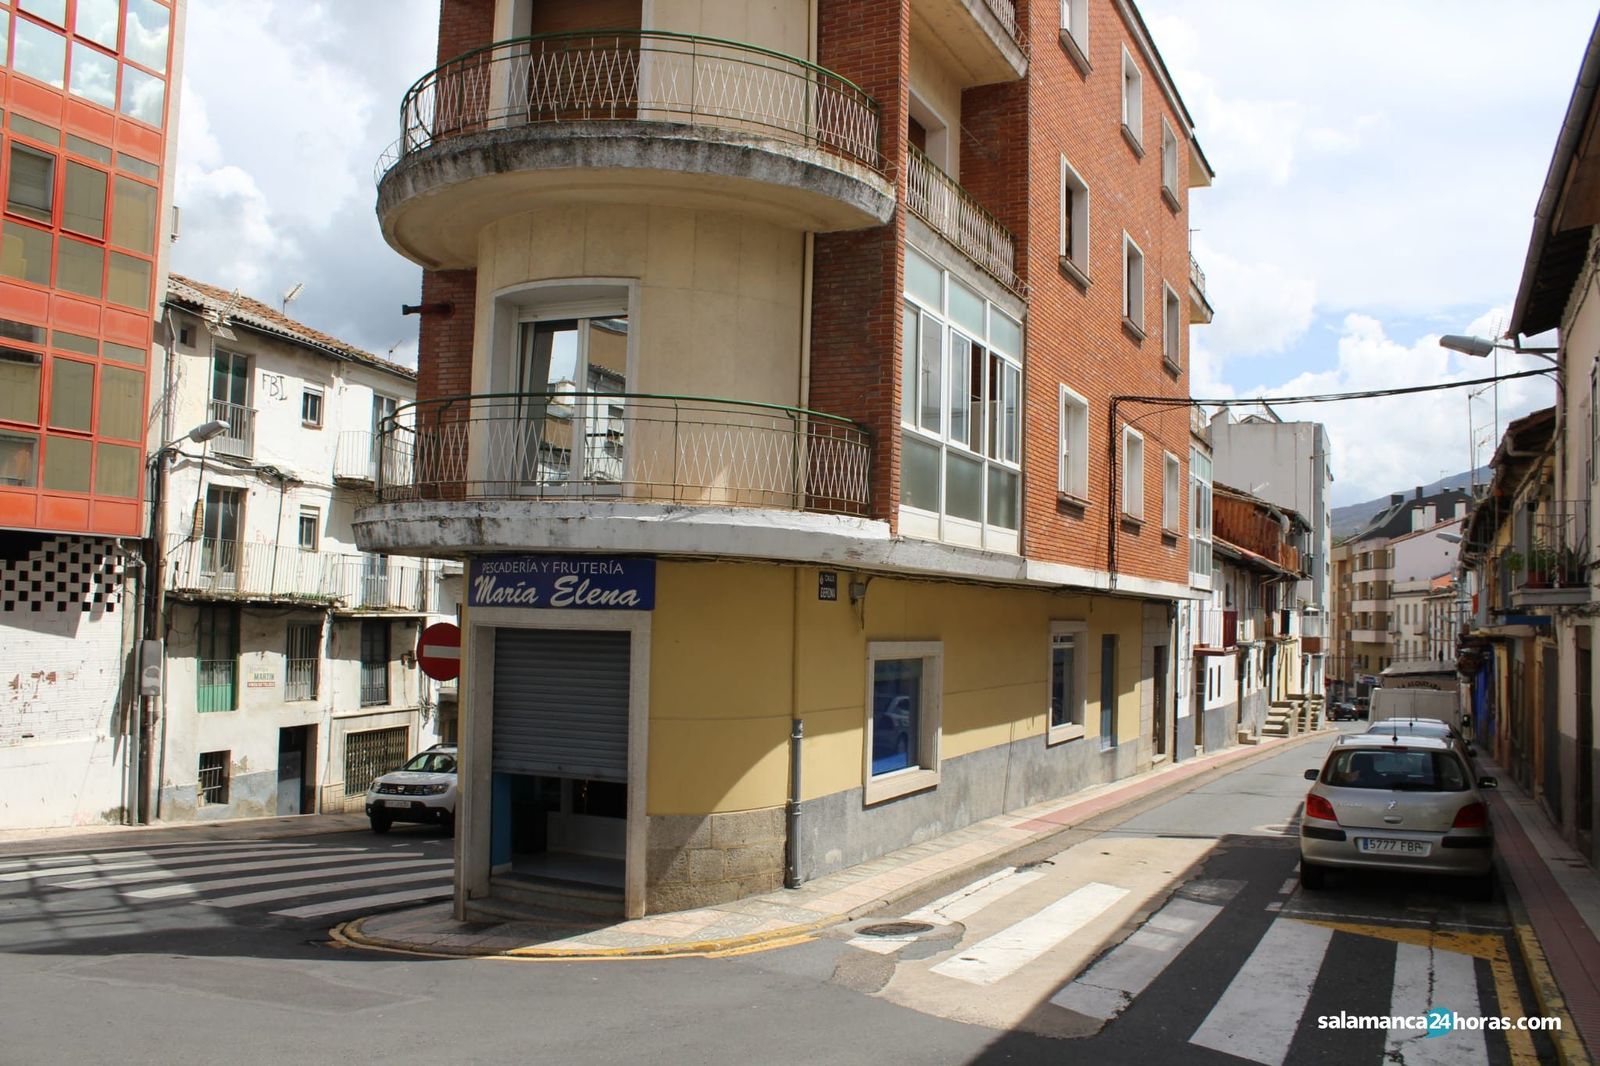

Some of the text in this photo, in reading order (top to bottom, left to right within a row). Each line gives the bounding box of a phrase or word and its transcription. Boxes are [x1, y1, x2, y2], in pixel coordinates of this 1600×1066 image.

[482, 560, 624, 575] PESCADERÍA Y FRUTERÍA
[474, 575, 641, 607] María Elena
[1370, 840, 1397, 850] 5777
